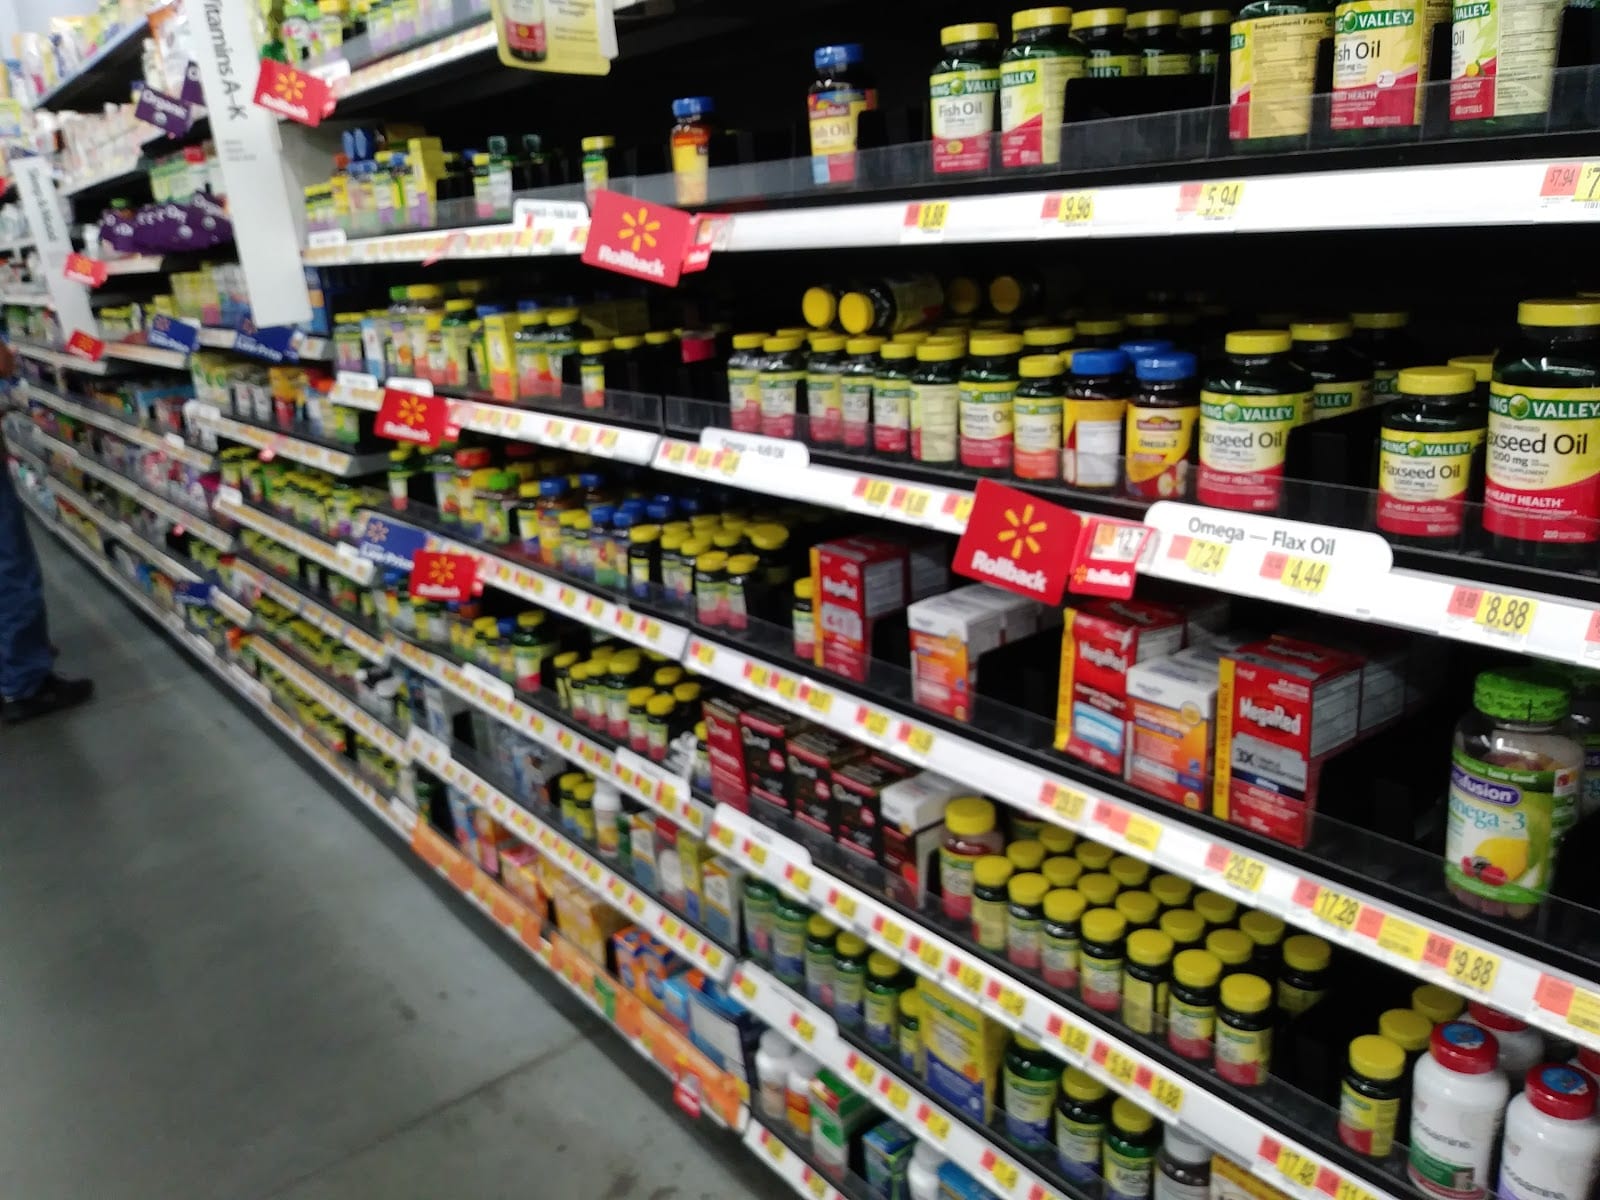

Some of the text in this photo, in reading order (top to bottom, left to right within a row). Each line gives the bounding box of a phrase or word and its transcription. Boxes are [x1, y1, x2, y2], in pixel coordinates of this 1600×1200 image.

[1358, 10, 1412, 28] VALLEY
[1455, 2, 1489, 19] VALLEY
[204, 0, 233, 76] itamins
[1335, 40, 1380, 61] sh Oil
[939, 101, 982, 118] Fish Oil
[598, 244, 665, 277] Rollback
[1242, 407, 1293, 420] VALLEY
[1533, 402, 1600, 418] VALLEY
[1203, 432, 1282, 448] axseed Oil
[1487, 433, 1588, 455] axseed Oil
[1426, 443, 1469, 456] VALLEY
[1512, 456, 1528, 467] mg
[1440, 464, 1460, 480] Oil
[1518, 496, 1561, 508] HEALTH
[1188, 517, 1245, 543] Omega
[1272, 531, 1307, 552] Flax
[1310, 537, 1336, 556] Oil
[971, 550, 1047, 593] Rollback
[1086, 567, 1131, 587] Rollback
[1290, 560, 1325, 588] 4.44
[1457, 771, 1512, 802] fusion
